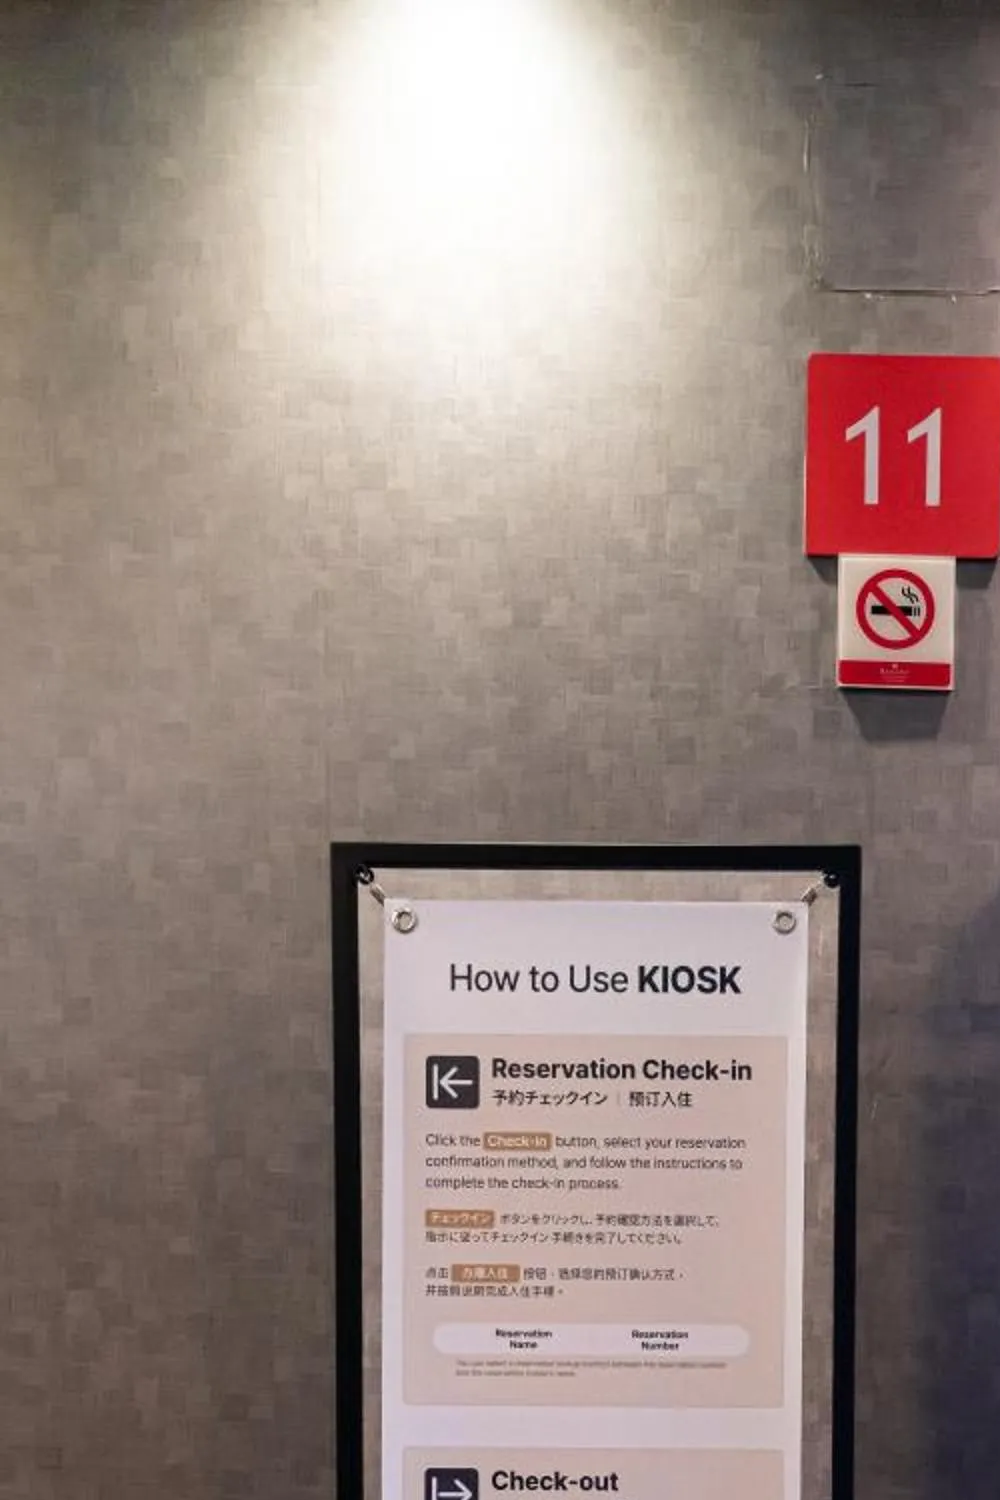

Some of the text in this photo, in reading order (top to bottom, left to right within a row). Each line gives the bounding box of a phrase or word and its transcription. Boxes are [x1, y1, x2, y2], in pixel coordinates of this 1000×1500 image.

[845, 405, 942, 507] 11
[449, 963, 742, 994] How to Use KIOSK
[491, 1057, 752, 1081] Reservation Check-in
[492, 1089, 609, 1107] 予約チェックイン
[424, 1133, 456, 1147] Click
[459, 1134, 481, 1147] the
[555, 1135, 600, 1149] button,
[602, 1136, 641, 1149] select
[644, 1137, 672, 1150] your
[675, 1136, 746, 1149] reservation
[425, 1155, 743, 1170] confirmation method, and follow the instructions to
[425, 1176, 485, 1190] complete
[487, 1177, 509, 1189] the
[511, 1177, 565, 1189] check-in
[495, 1328, 553, 1339] Reservation
[631, 1329, 689, 1340] Reservation
[509, 1340, 538, 1350] Name
[641, 1341, 680, 1351] Number
[491, 1470, 619, 1492] Check-out
